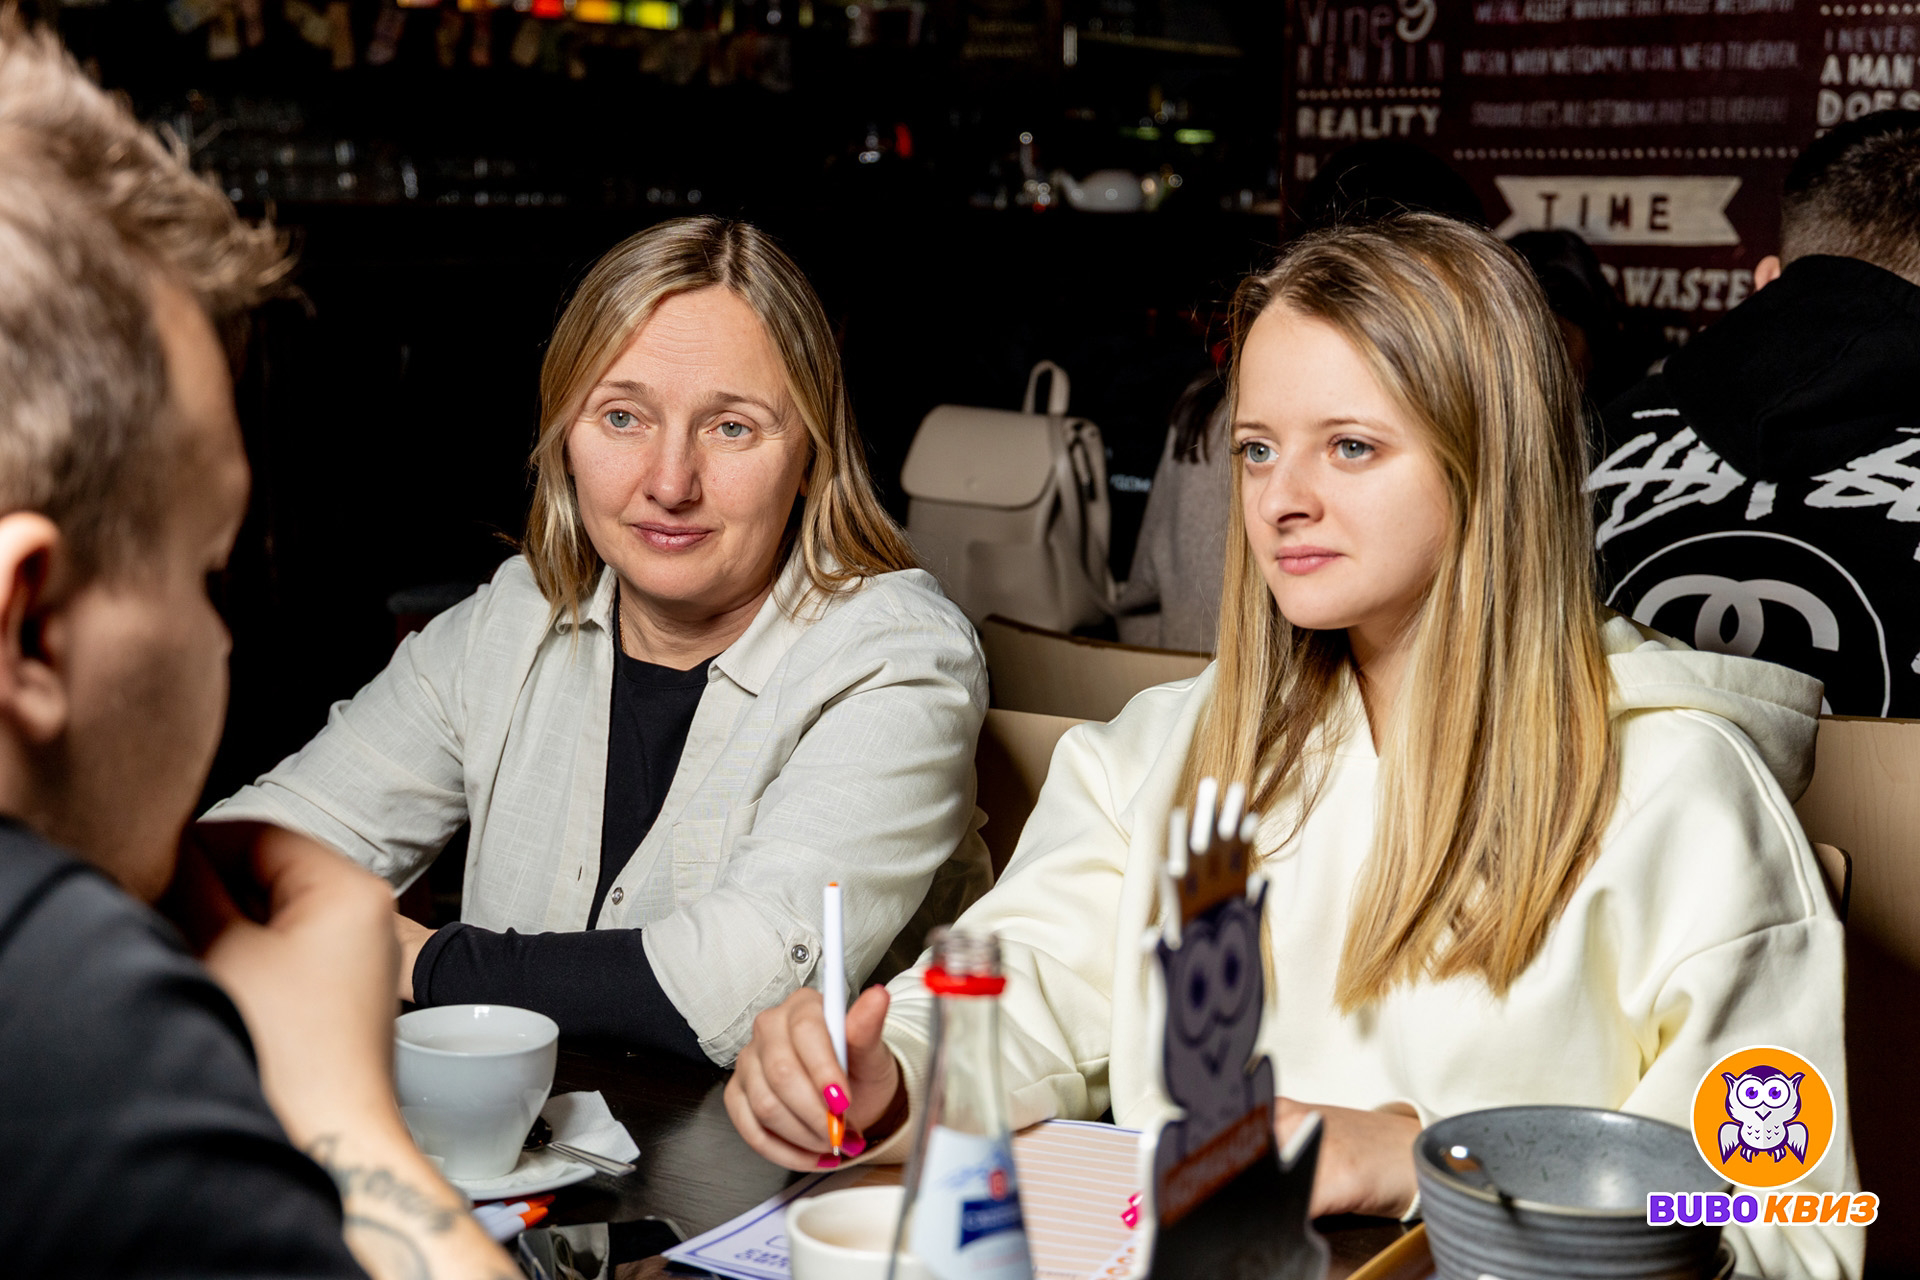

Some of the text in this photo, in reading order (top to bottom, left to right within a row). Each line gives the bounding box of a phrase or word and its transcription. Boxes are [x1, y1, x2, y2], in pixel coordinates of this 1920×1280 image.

[1820, 53, 1842, 86] A
[1847, 53, 1915, 88] MAN
[1297, 105, 1441, 141] REALITY
[1538, 192, 1670, 231] TIME
